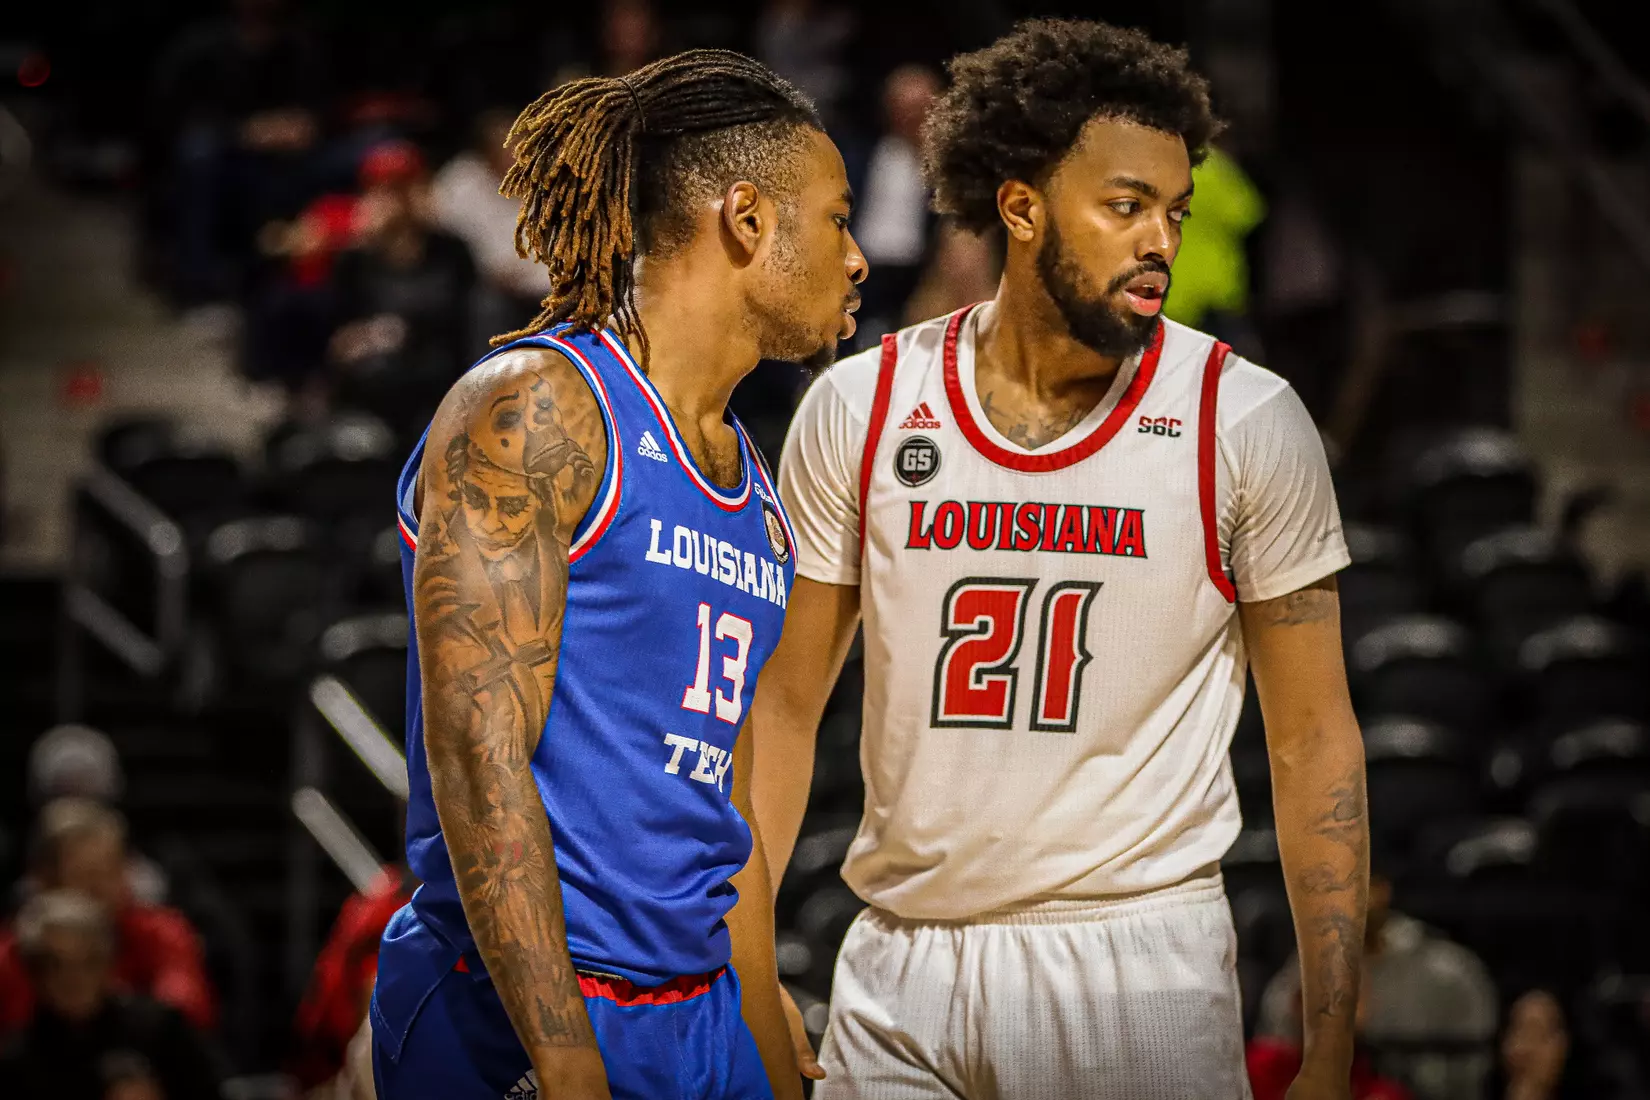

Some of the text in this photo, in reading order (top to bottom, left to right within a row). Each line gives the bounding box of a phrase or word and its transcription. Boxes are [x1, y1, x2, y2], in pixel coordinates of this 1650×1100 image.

[902, 448, 932, 471] GS
[645, 518, 787, 610] LOUISIANA
[905, 500, 1148, 559] LOUISIANA
[680, 601, 754, 726] 13
[930, 576, 1104, 733] 21
